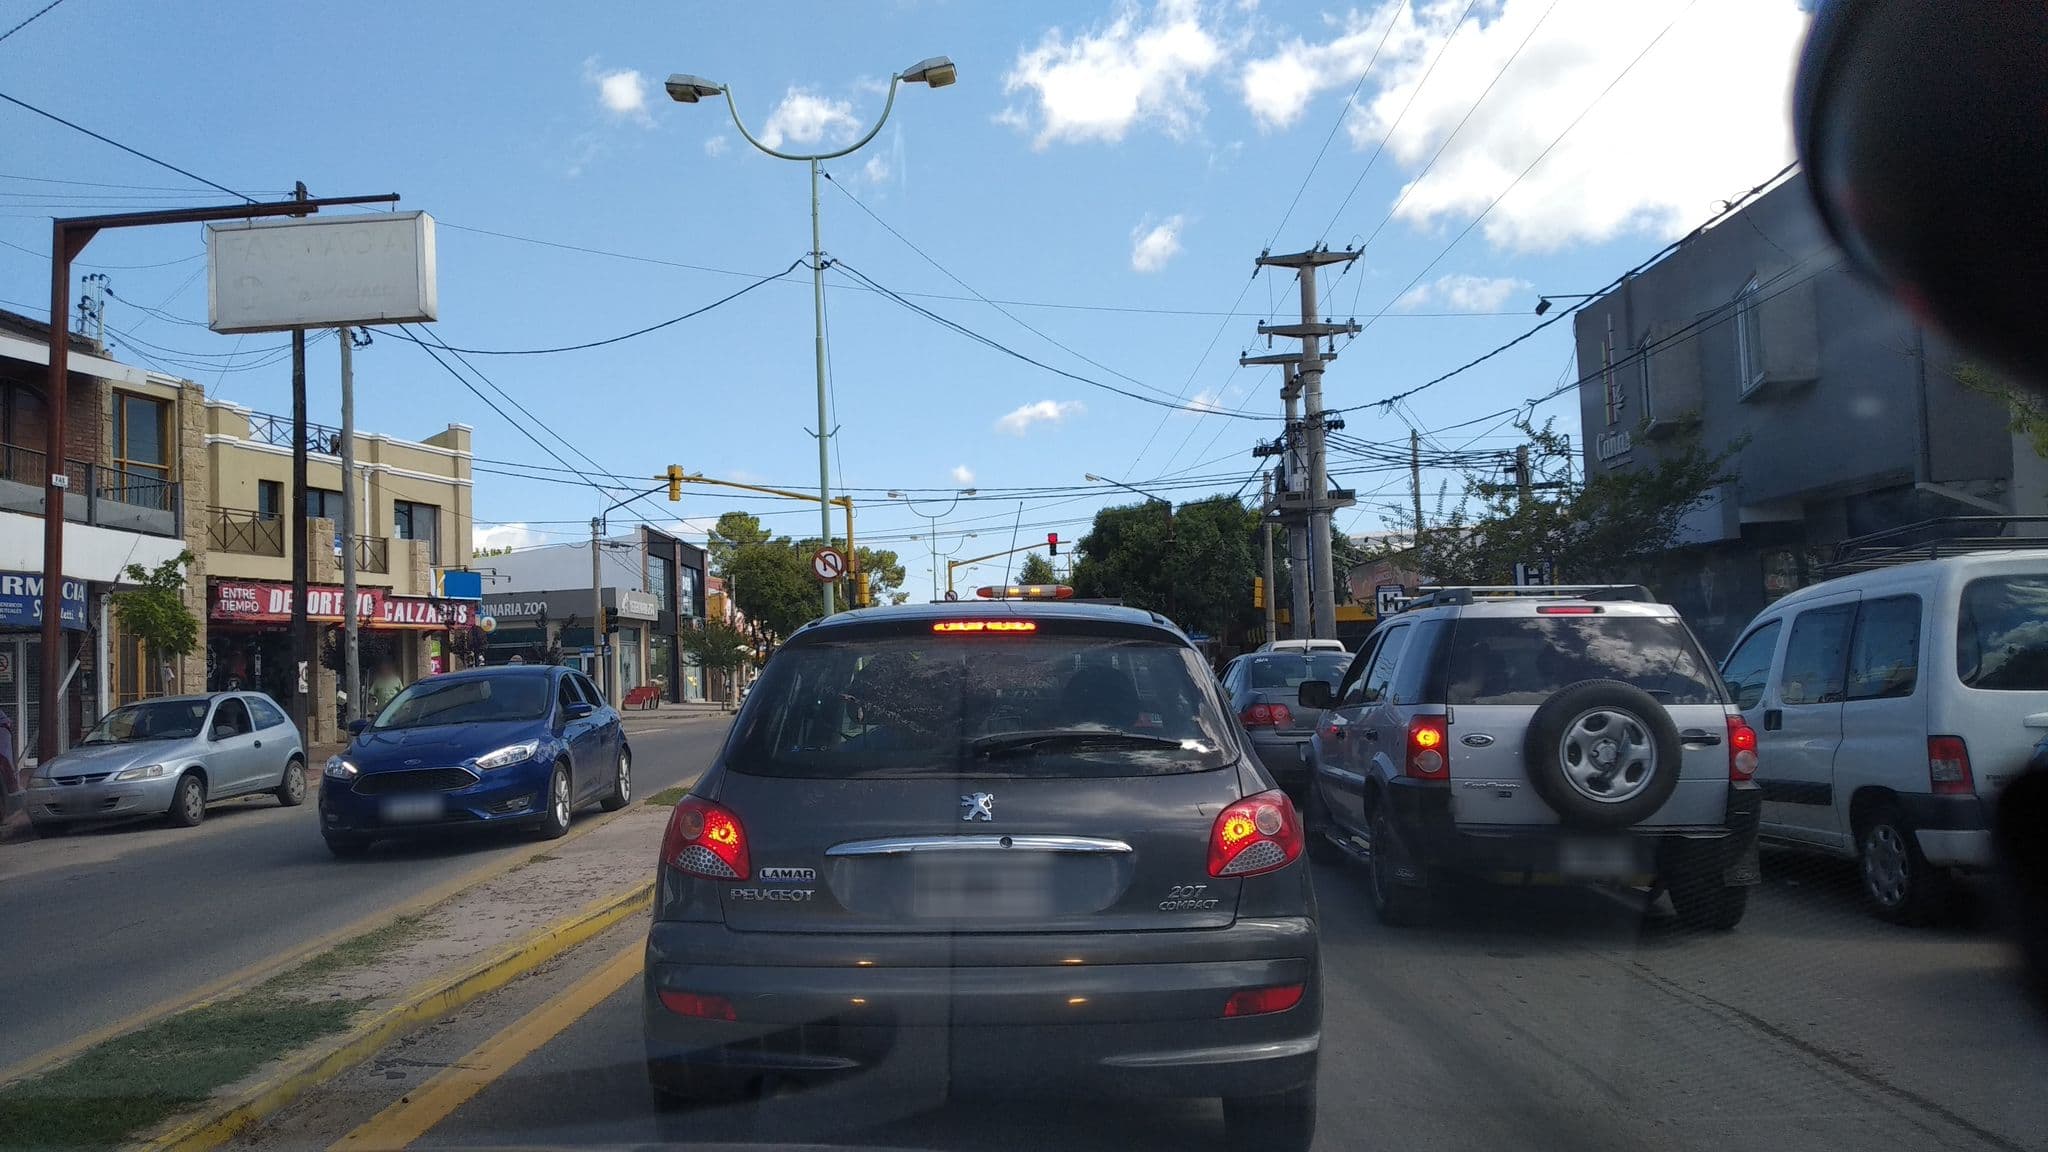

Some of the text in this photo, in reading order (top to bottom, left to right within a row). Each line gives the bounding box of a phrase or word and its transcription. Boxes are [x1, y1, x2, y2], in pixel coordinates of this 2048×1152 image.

[0, 576, 85, 602] RMCIA
[222, 587, 256, 600] ENTRE
[221, 599, 260, 613] TIEMPO
[523, 601, 548, 615] ZOO
[761, 869, 814, 879] LAMAR
[730, 888, 816, 902] PEUGEOT
[1168, 885, 1208, 899] 207
[1158, 899, 1219, 911] COMPACT
